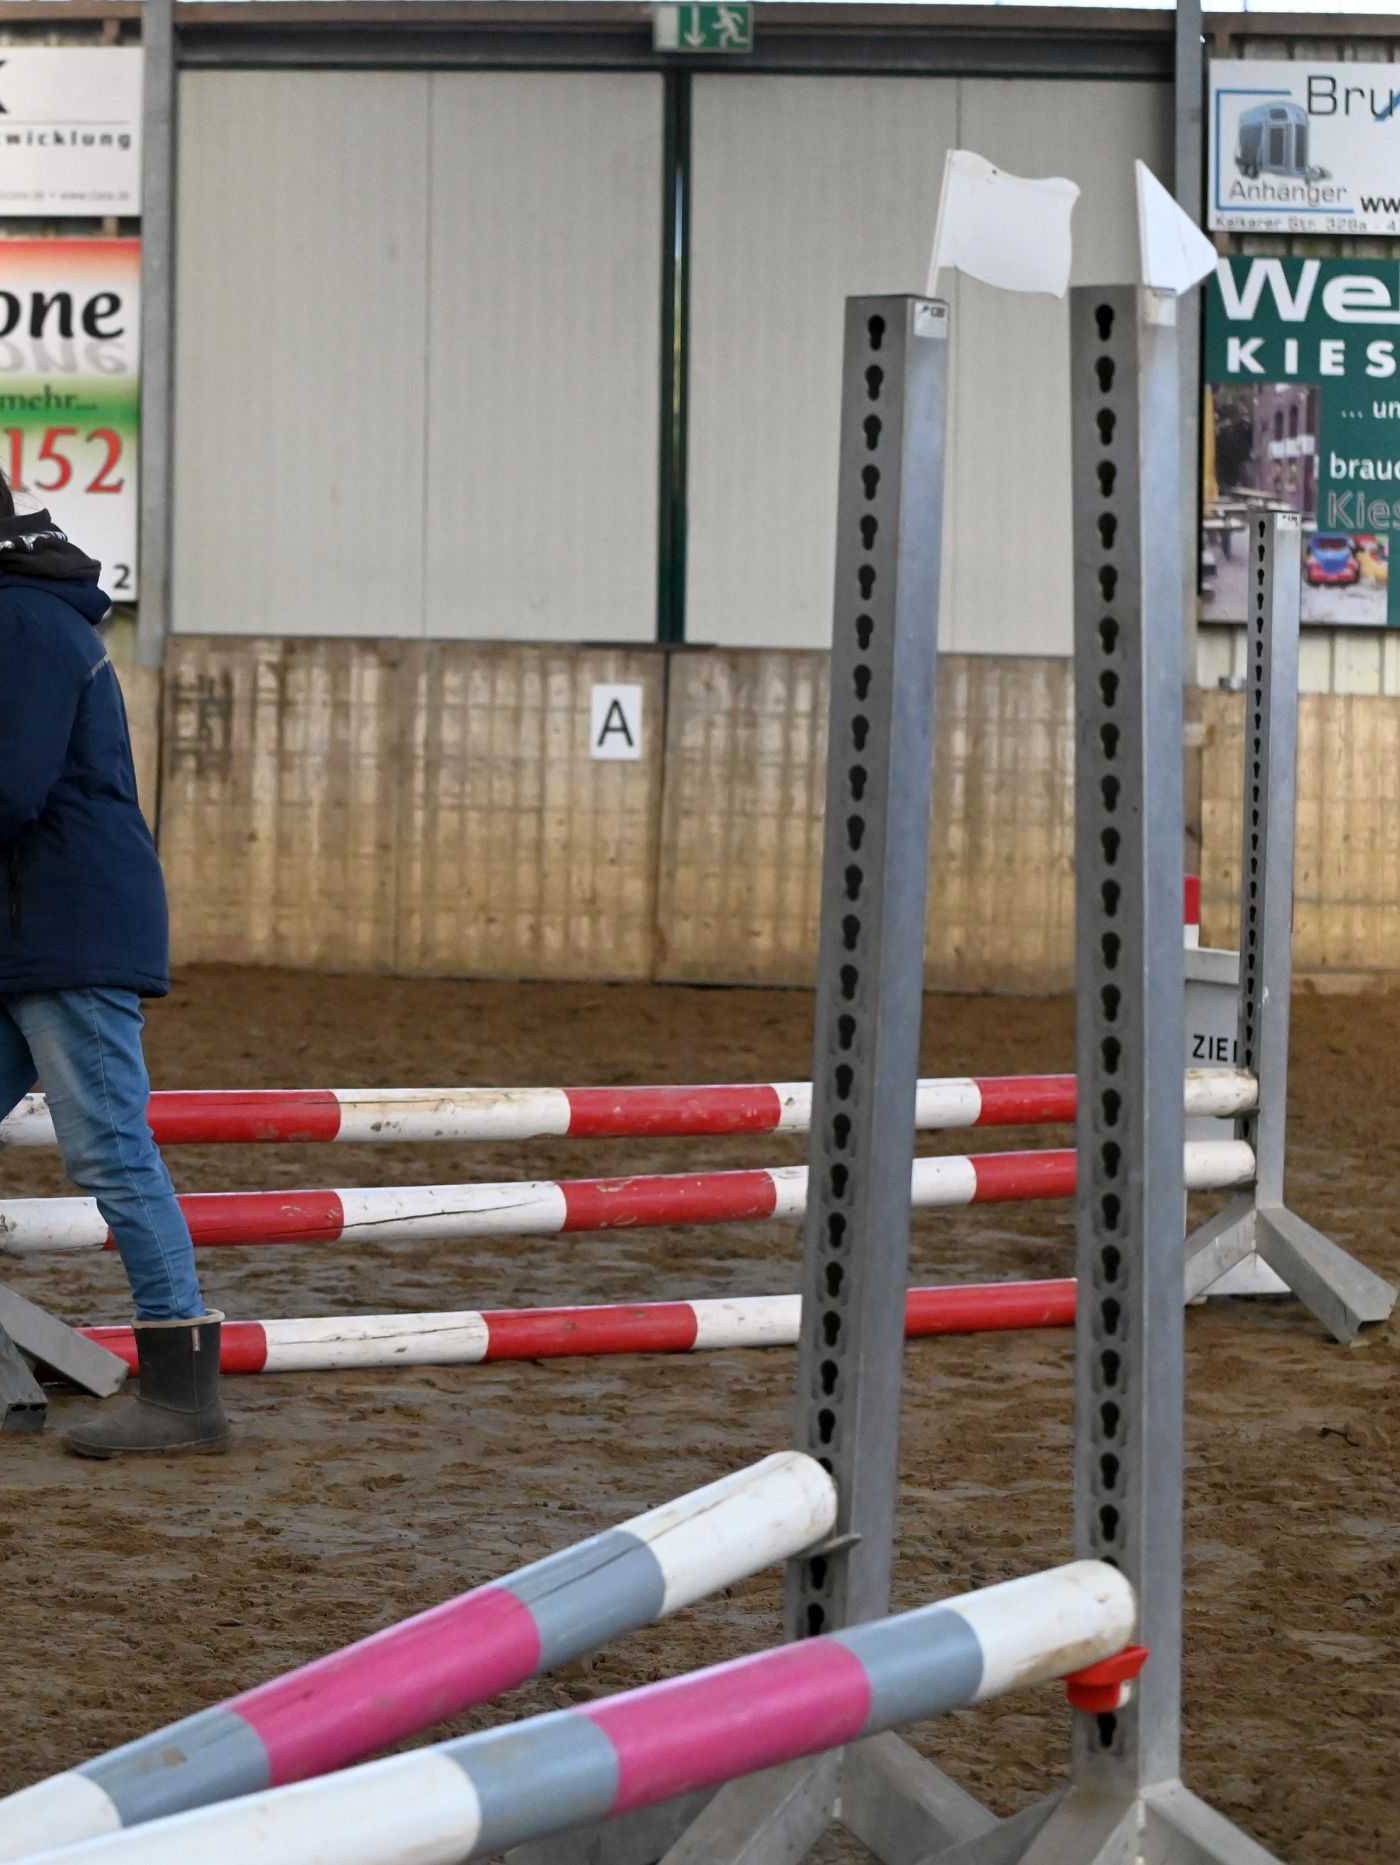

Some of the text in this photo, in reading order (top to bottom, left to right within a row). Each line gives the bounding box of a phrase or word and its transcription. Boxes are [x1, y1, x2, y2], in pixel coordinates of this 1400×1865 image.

[1306, 75, 1394, 119] Bru
[1216, 257, 1400, 325] We
[1227, 337, 1397, 378] KIES
[597, 698, 634, 748] A
